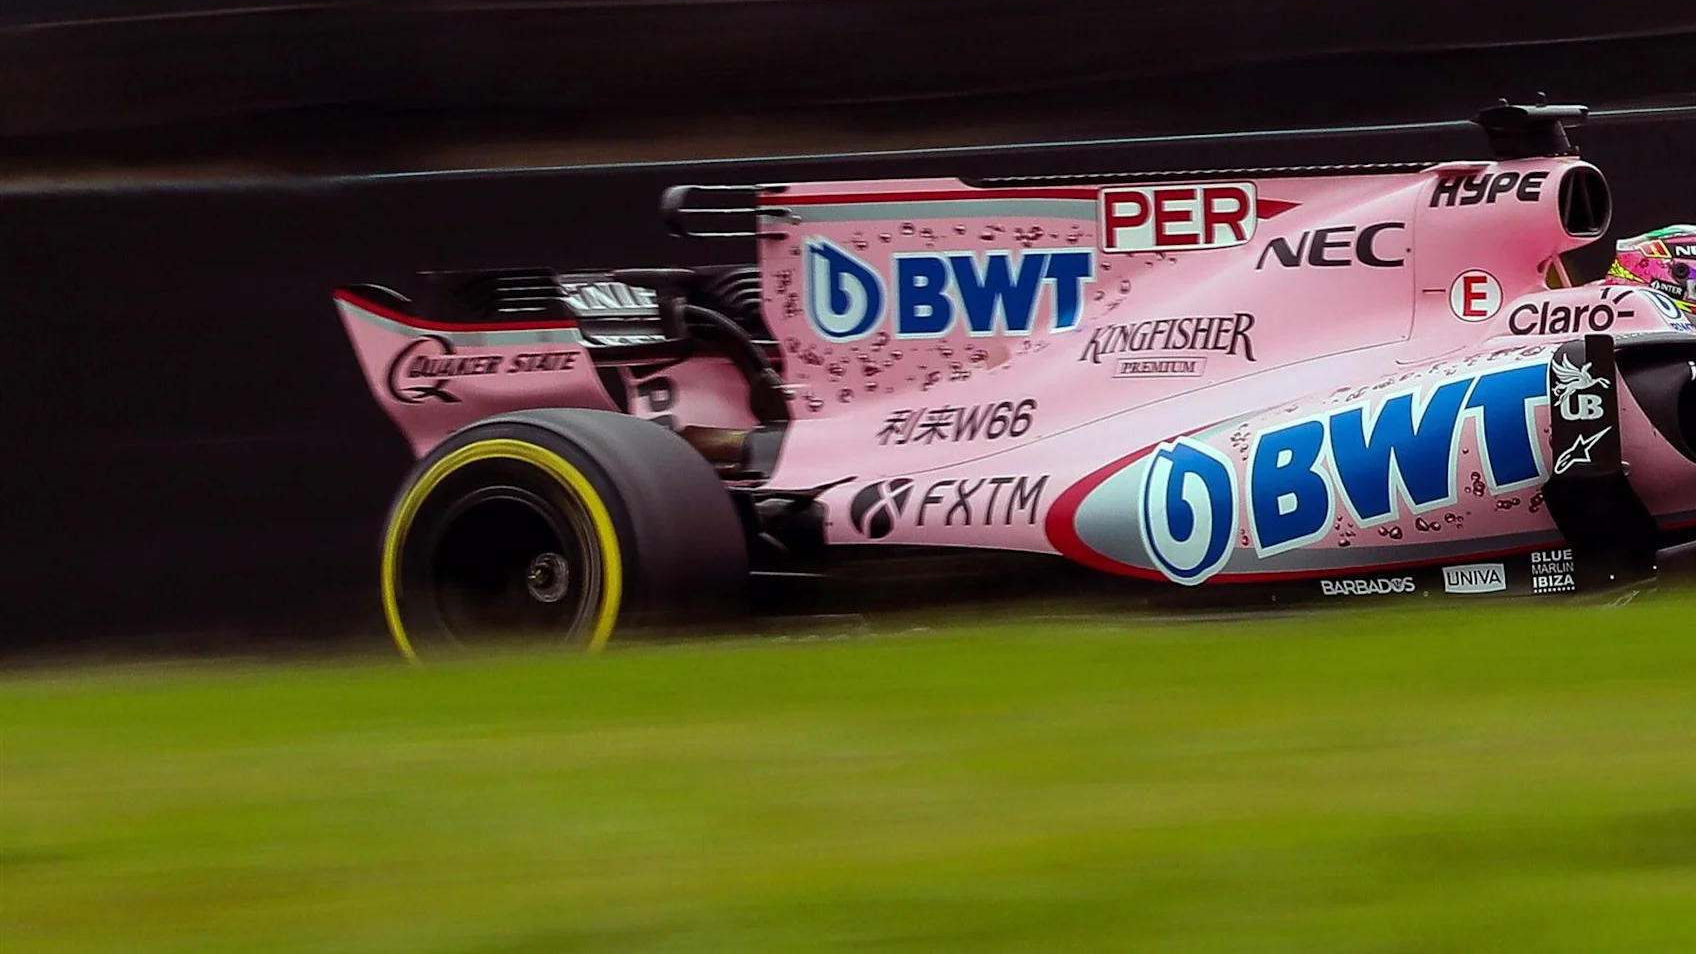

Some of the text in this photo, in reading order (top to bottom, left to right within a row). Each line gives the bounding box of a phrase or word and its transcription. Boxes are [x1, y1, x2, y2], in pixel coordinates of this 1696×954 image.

[1428, 170, 1550, 208] HYPE
[1103, 189, 1253, 246] PER
[1256, 221, 1406, 270] NEC
[892, 249, 1097, 340] BWT
[1462, 275, 1489, 318] E
[1078, 313, 1258, 364] KINGFISHER
[505, 350, 582, 374] STATE
[1120, 360, 1196, 374] PREMIUM
[1247, 362, 1551, 552] BWT
[915, 475, 1051, 526] FXTM
[1531, 549, 1573, 563] BLUE
[1531, 562, 1575, 574] MARLIN
[1321, 577, 1416, 595] BARBADOS
[1449, 569, 1502, 586] UNIVA
[1532, 575, 1575, 589] IBIZA
